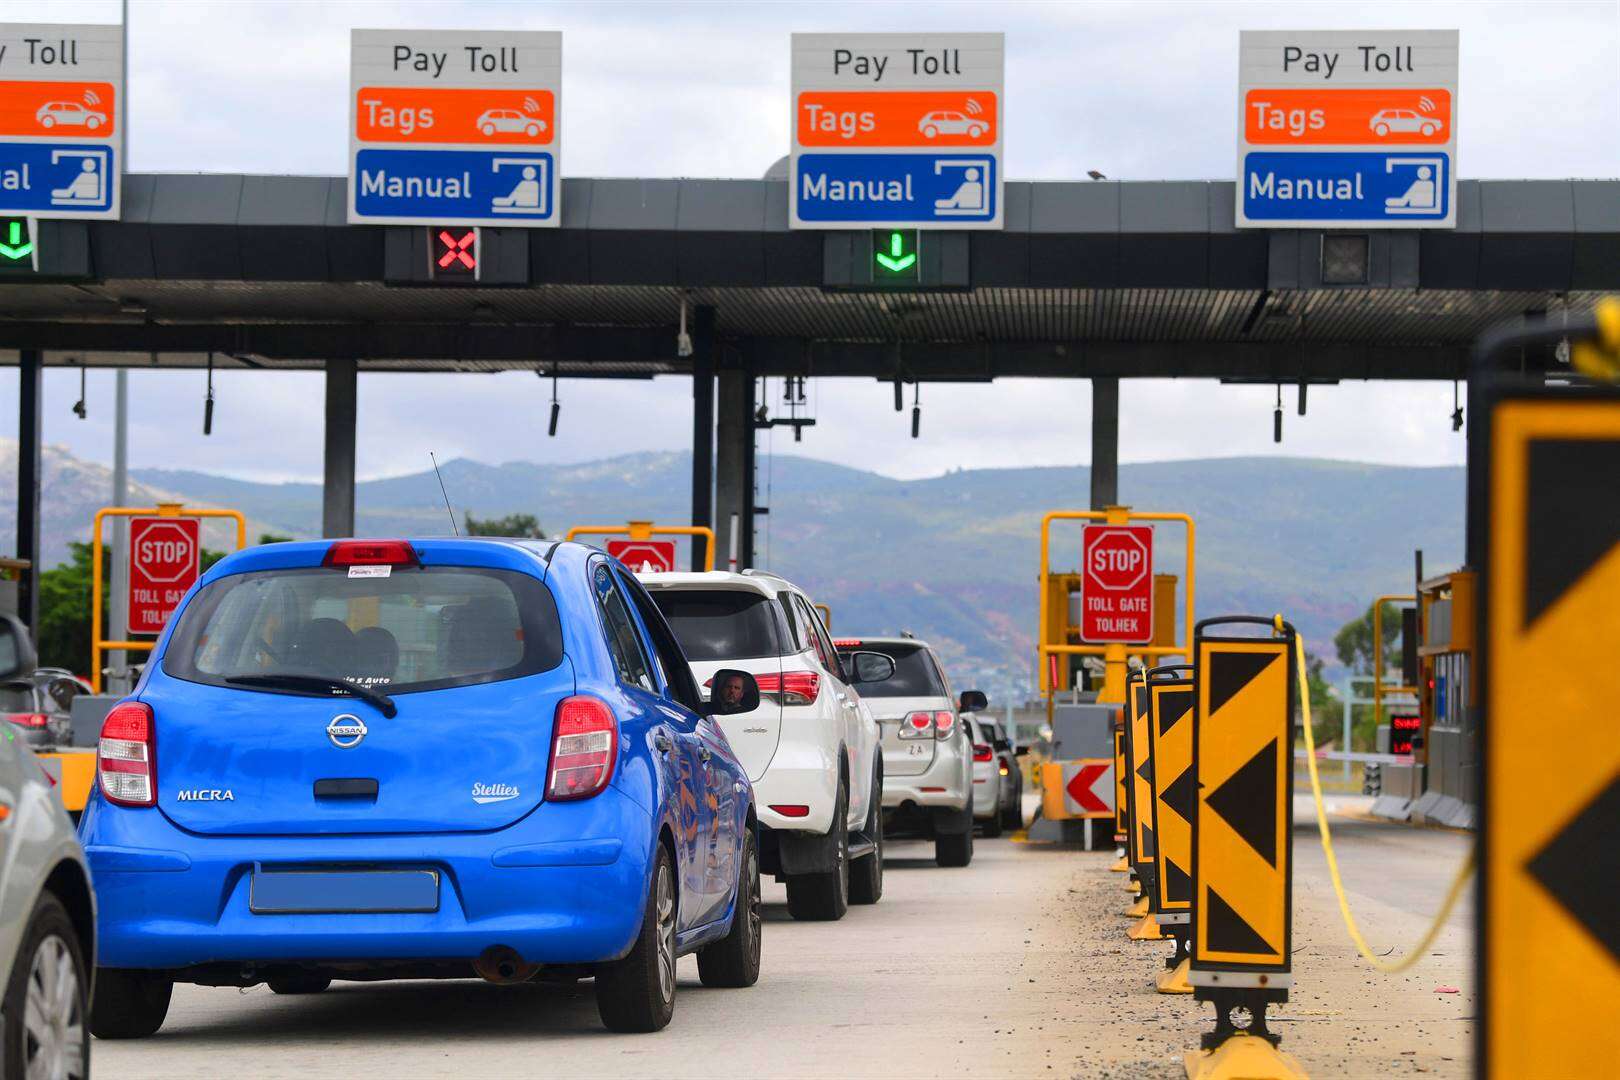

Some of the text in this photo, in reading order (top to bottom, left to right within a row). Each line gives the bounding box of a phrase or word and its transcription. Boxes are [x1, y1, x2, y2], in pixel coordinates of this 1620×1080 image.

[24, 38, 79, 66] Toll
[393, 45, 519, 79] Pay Toll
[833, 48, 961, 82] Pay Toll
[1283, 45, 1414, 79] Pay Toll
[362, 100, 435, 136] Tags
[803, 104, 876, 139] Tags
[1251, 102, 1326, 137] Tags
[360, 169, 472, 199] Manual
[802, 173, 914, 202] Manual
[1249, 171, 1364, 200] Manual
[141, 540, 188, 564] STOP
[1094, 548, 1141, 572] STOP
[133, 588, 187, 604] TOLL GAT
[1087, 596, 1148, 612] TOLL GATE
[1095, 617, 1139, 633] TOLHEK
[329, 727, 363, 735] NISSAN
[177, 789, 235, 801] MICRA
[471, 781, 520, 797] Stellies
